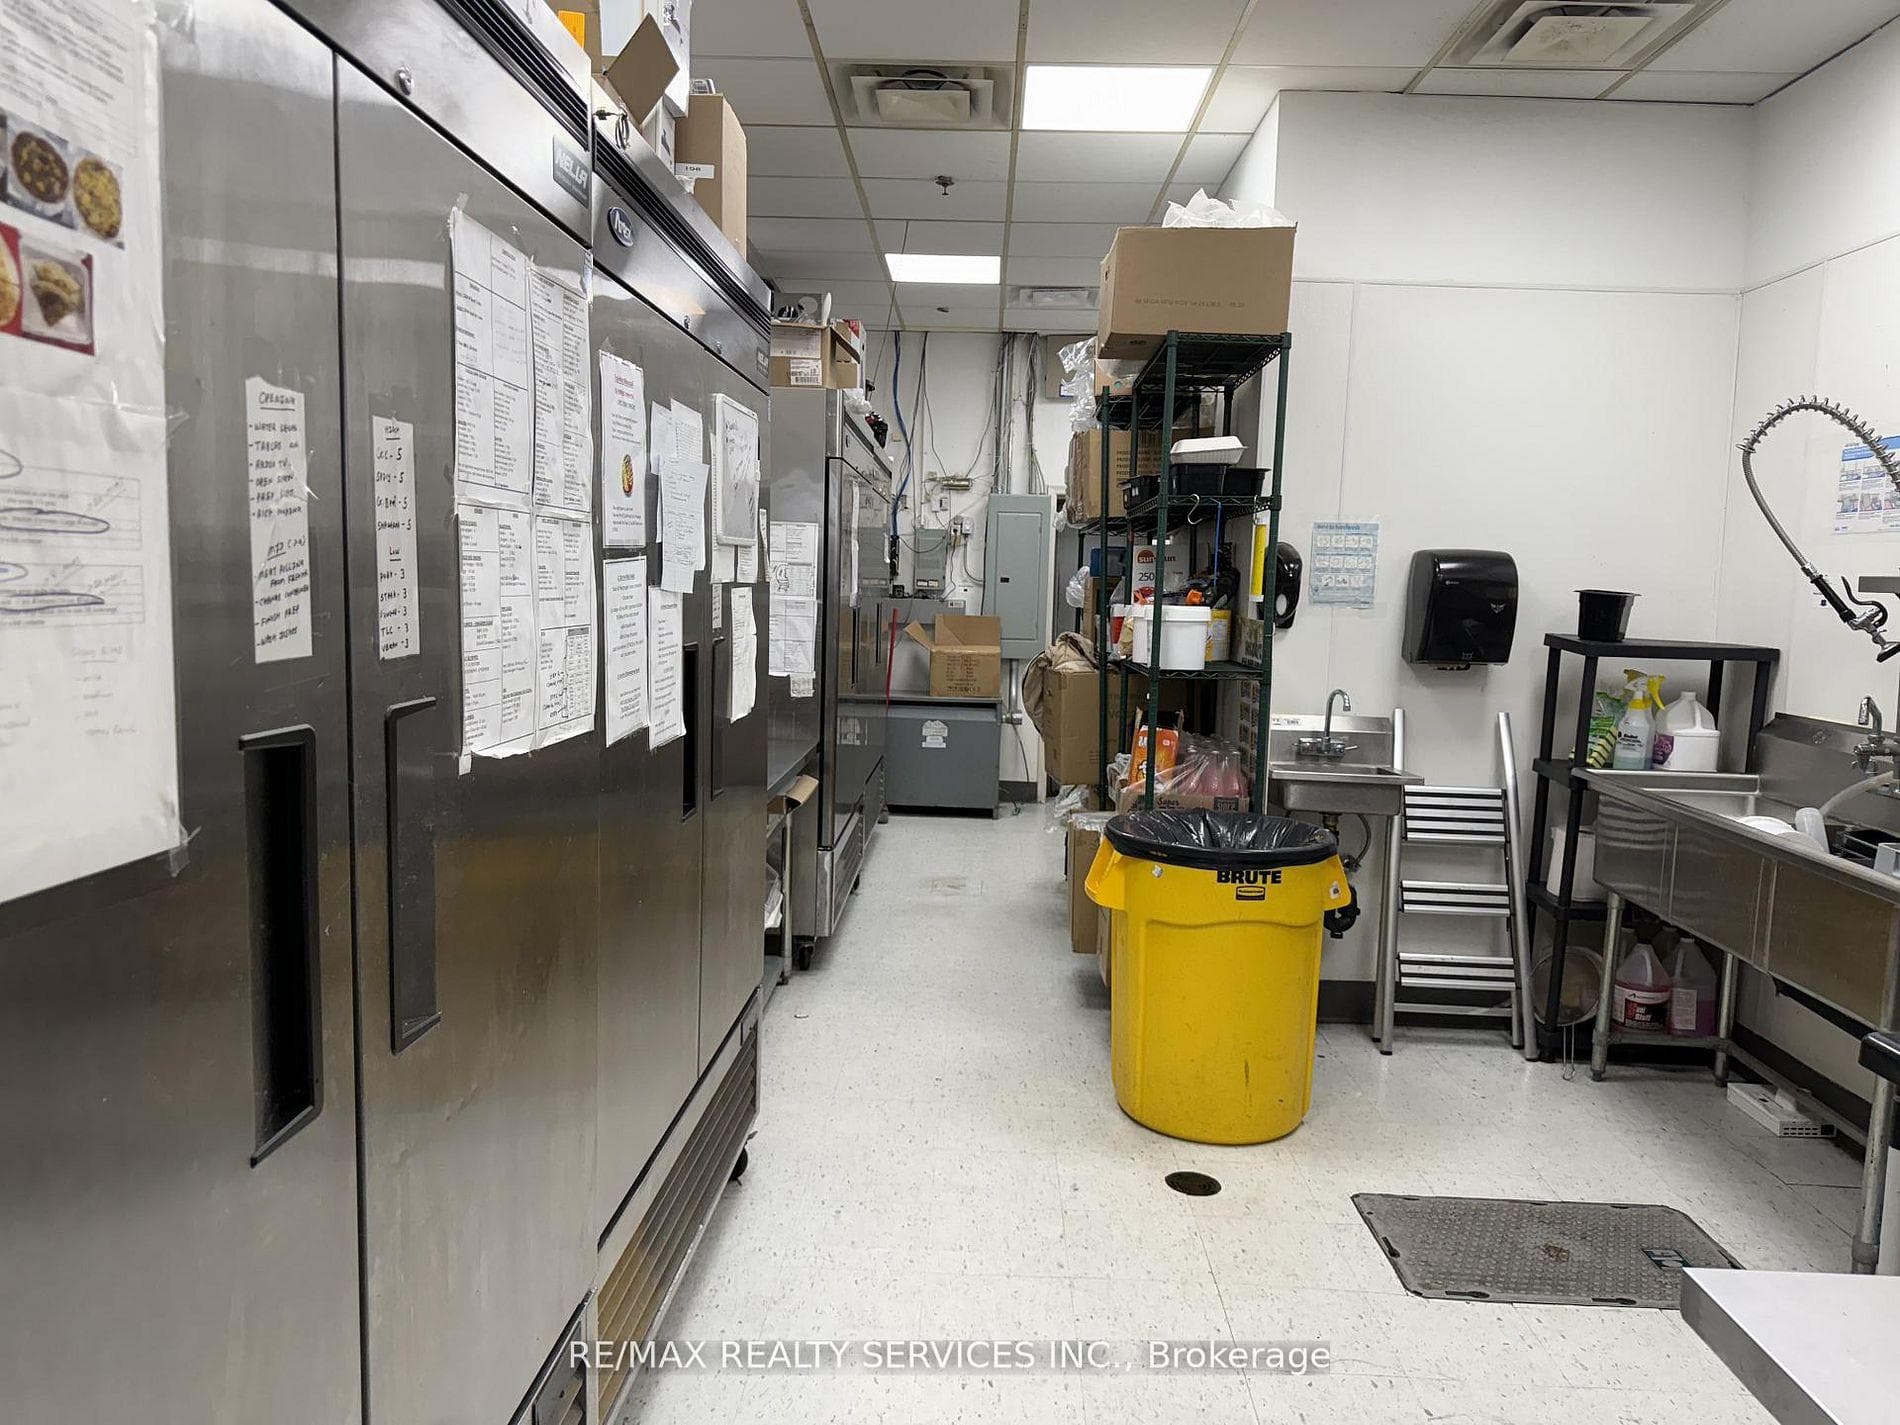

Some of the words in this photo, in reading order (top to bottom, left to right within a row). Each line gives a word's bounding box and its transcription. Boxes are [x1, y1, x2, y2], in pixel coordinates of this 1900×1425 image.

[555, 145, 588, 190] NELLA
[1138, 572, 1155, 582] 250
[1216, 870, 1282, 884] BRUTE
